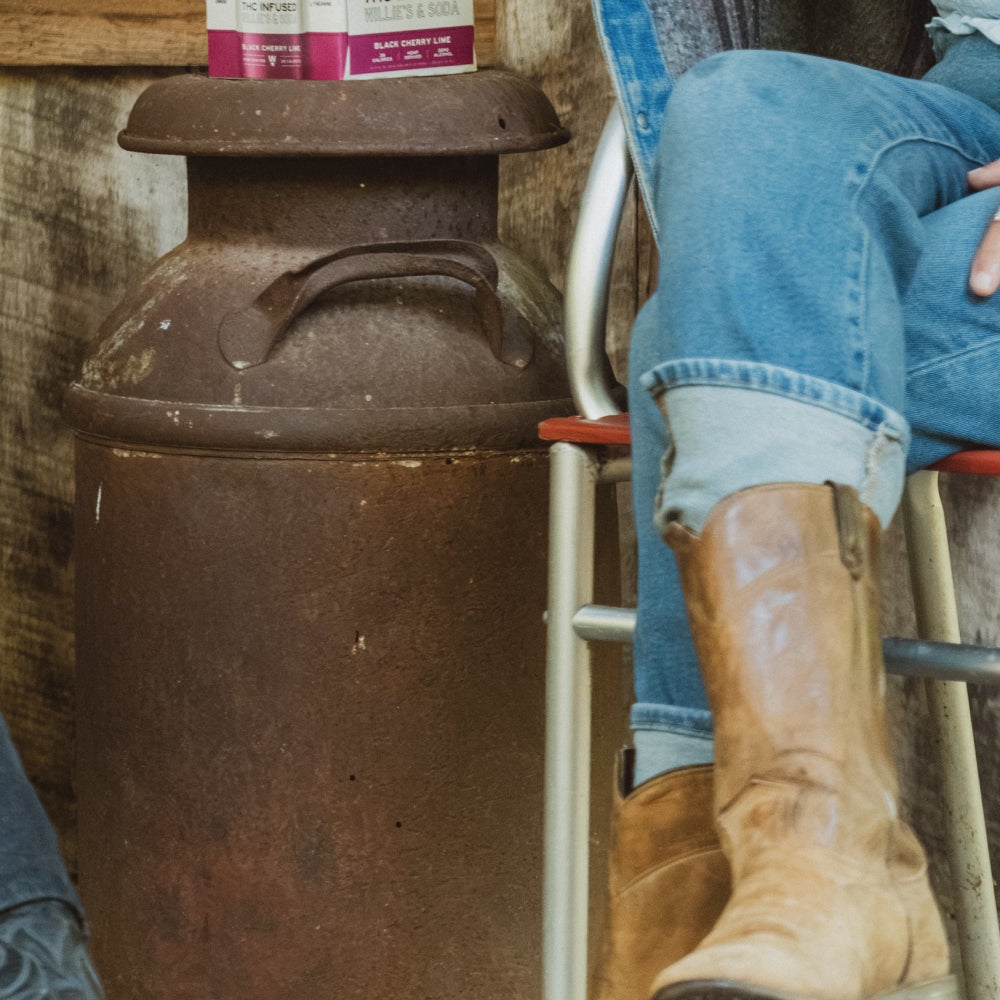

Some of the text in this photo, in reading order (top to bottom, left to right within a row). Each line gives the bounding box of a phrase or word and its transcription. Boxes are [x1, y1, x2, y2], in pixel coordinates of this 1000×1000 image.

[241, 1, 258, 12] THC
[259, 1, 297, 12] INFUSED
[364, 3, 415, 23] WILLIE'S
[428, 0, 460, 18] SODA
[241, 43, 302, 53] BLACK CHERRY LIME
[373, 34, 452, 51] BLACK CHERRY LIME
